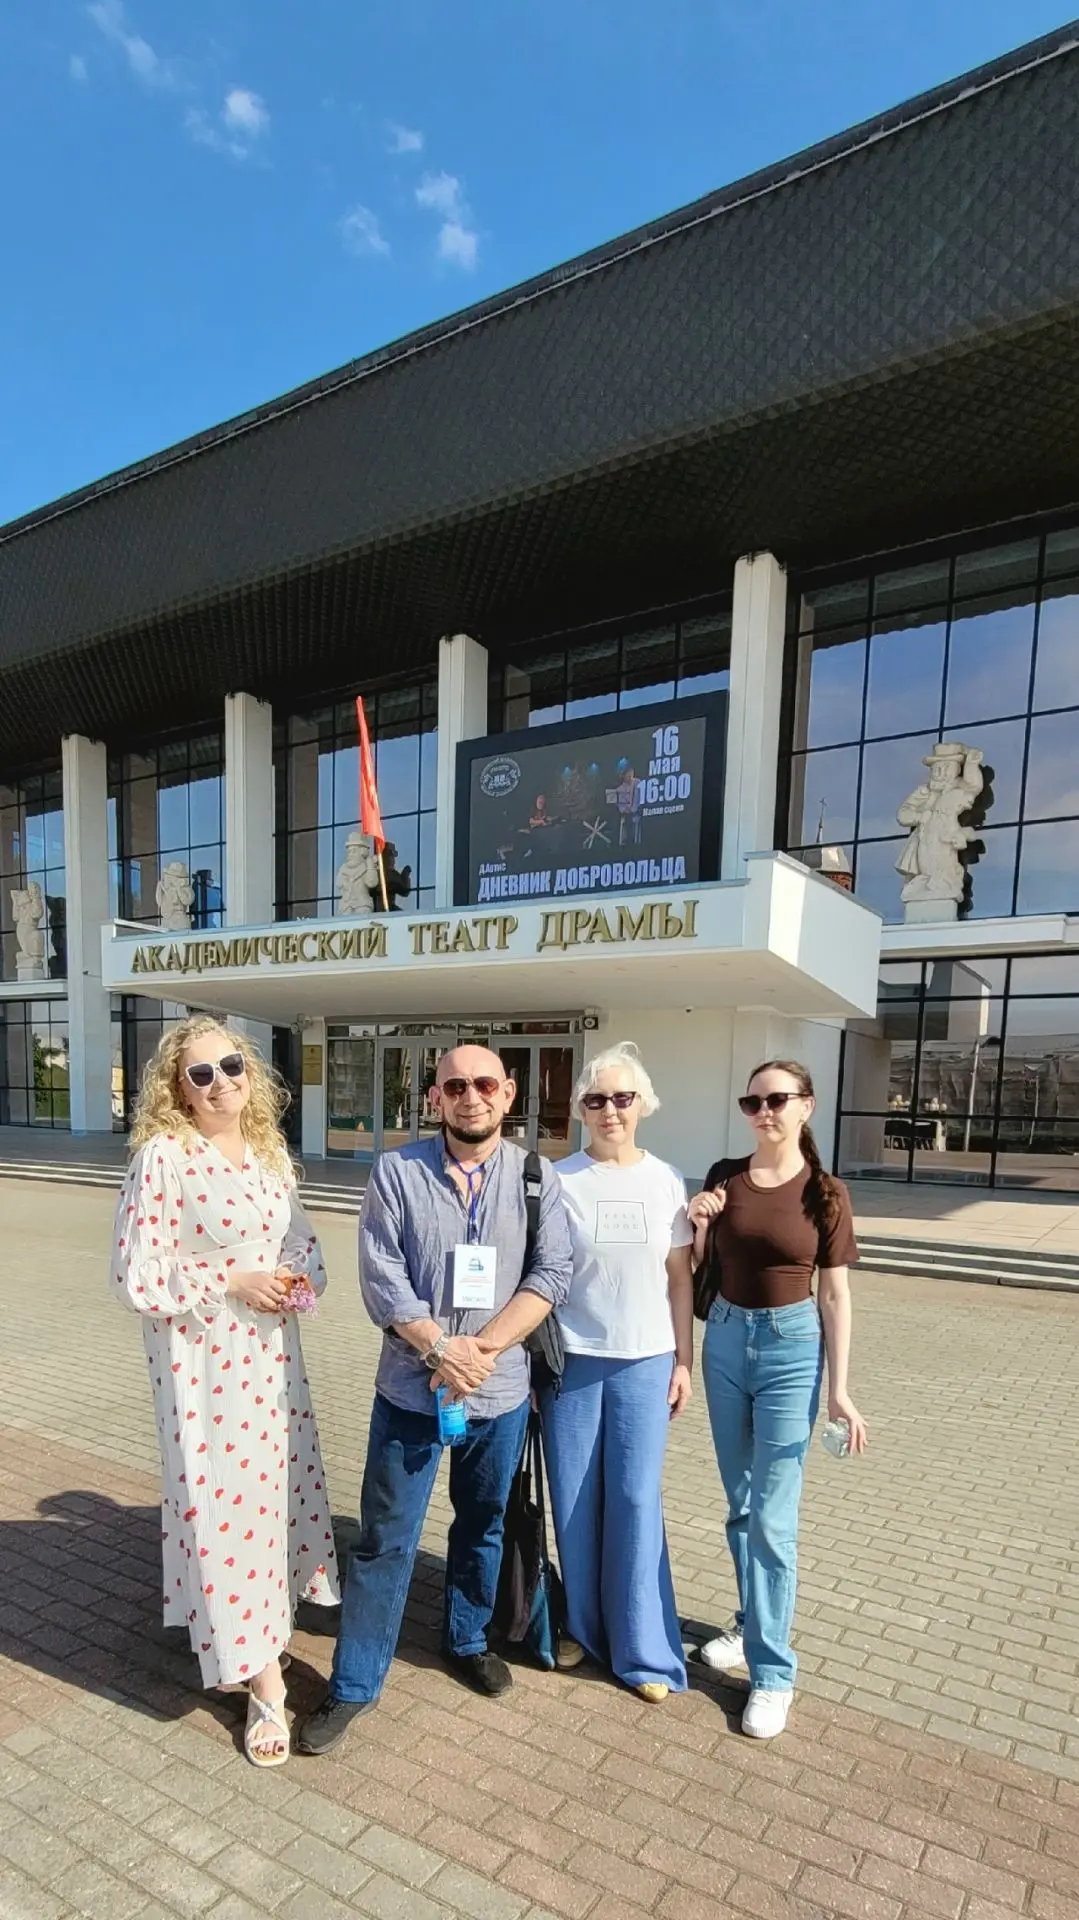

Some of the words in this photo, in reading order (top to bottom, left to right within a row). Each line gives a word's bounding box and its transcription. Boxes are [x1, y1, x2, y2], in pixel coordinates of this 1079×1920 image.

[652, 725, 679, 758] 16
[648, 756, 681, 777] мая
[637, 773, 691, 805] 16:00
[477, 871, 551, 902] ДНЕВНИК
[553, 856, 686, 895] ДОБРОВОЛЬЦА
[130, 921, 388, 975] АКАДЕМИЧЕСКИЙ
[407, 914, 519, 955] ТЕАТР
[536, 899, 700, 953] ДРАМЫ
